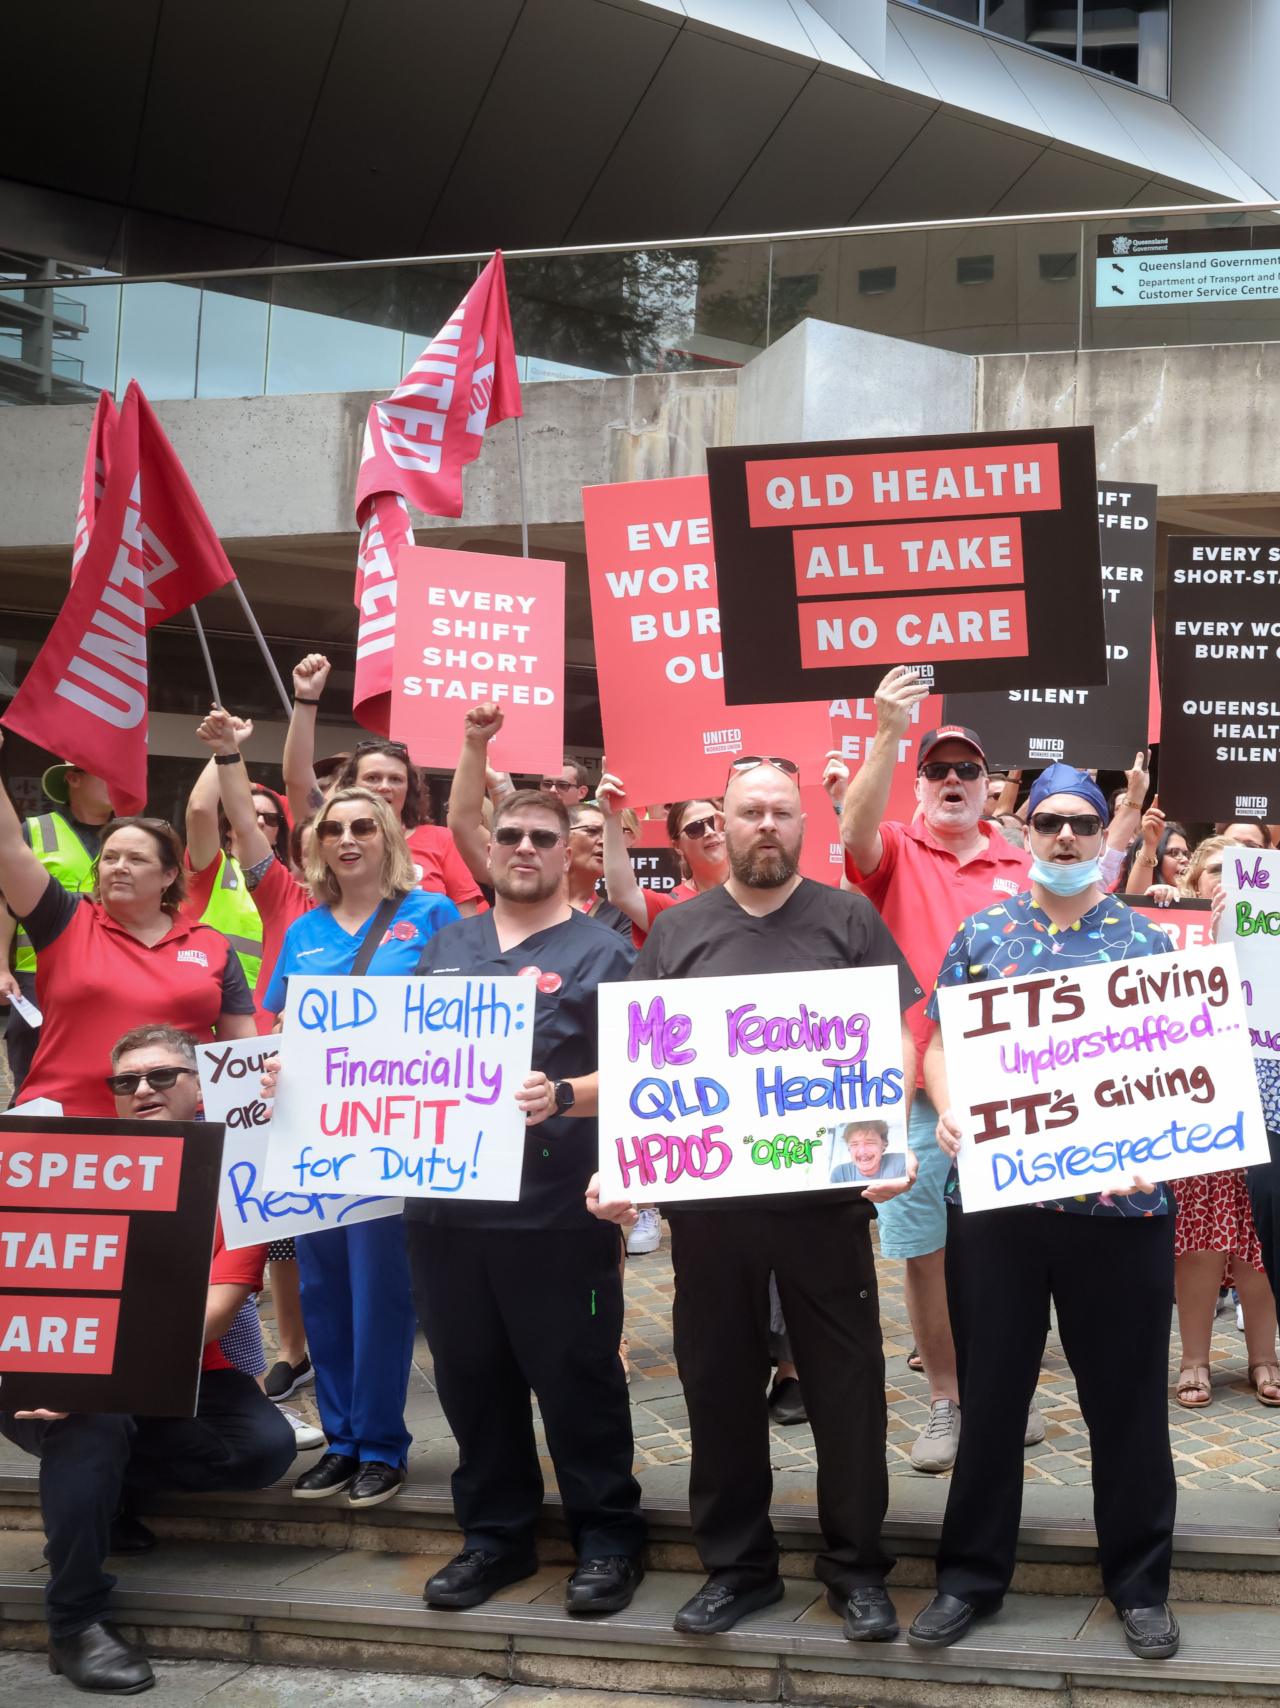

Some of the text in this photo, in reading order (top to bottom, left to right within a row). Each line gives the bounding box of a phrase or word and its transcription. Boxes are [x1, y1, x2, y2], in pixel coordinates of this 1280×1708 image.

[1132, 237, 1168, 247] Queensland
[1132, 244, 1168, 253] Government
[1138, 276, 1195, 289] Department
[1198, 274, 1207, 283] of
[1209, 271, 1254, 285] Transport
[1257, 272, 1276, 281] and
[1139, 258, 1207, 273] Queensland
[1138, 284, 1279, 301] Customer Service Centre
[766, 461, 1041, 510] QLD HEALTH
[1097, 491, 1132, 507] IFT
[627, 517, 711, 551] EVE
[806, 535, 1012, 579] ALL TAKE
[1192, 547, 1261, 562] EVERY
[605, 563, 718, 599] WOR
[1101, 566, 1144, 582] KER
[428, 587, 537, 614] EVERY
[432, 617, 531, 644] SHIFT
[630, 607, 721, 642] BUR
[816, 609, 1011, 650] NO CARE
[1175, 622, 1243, 637] EVERY
[422, 646, 538, 674] SHORT
[665, 652, 724, 684] OU
[1195, 645, 1269, 660] BURNT
[402, 676, 555, 707] STAFFED
[1008, 689, 1089, 705] SILENT
[702, 728, 742, 745] UNITED
[1029, 737, 1065, 751] UNITED
[1235, 796, 1268, 808] UNITED
[1235, 857, 1270, 889] We
[1108, 963, 1229, 1009] Giving
[299, 988, 377, 1033] QLD
[403, 981, 526, 1038] Health:
[627, 995, 870, 1069] Me reading
[999, 1002, 1240, 1084] Understaffed...
[326, 1045, 502, 1105] Financially
[629, 1060, 904, 1122] QLD Healths
[1094, 1065, 1215, 1108] Giving
[226, 1101, 268, 1130] are
[320, 1096, 460, 1145] UNFIT
[292, 1131, 484, 1192] for Duty!
[991, 1111, 1245, 1191] Disrespected
[5, 1151, 163, 1192] SPECT
[1, 1232, 119, 1271] TAFF
[0, 1316, 99, 1354] ARE
